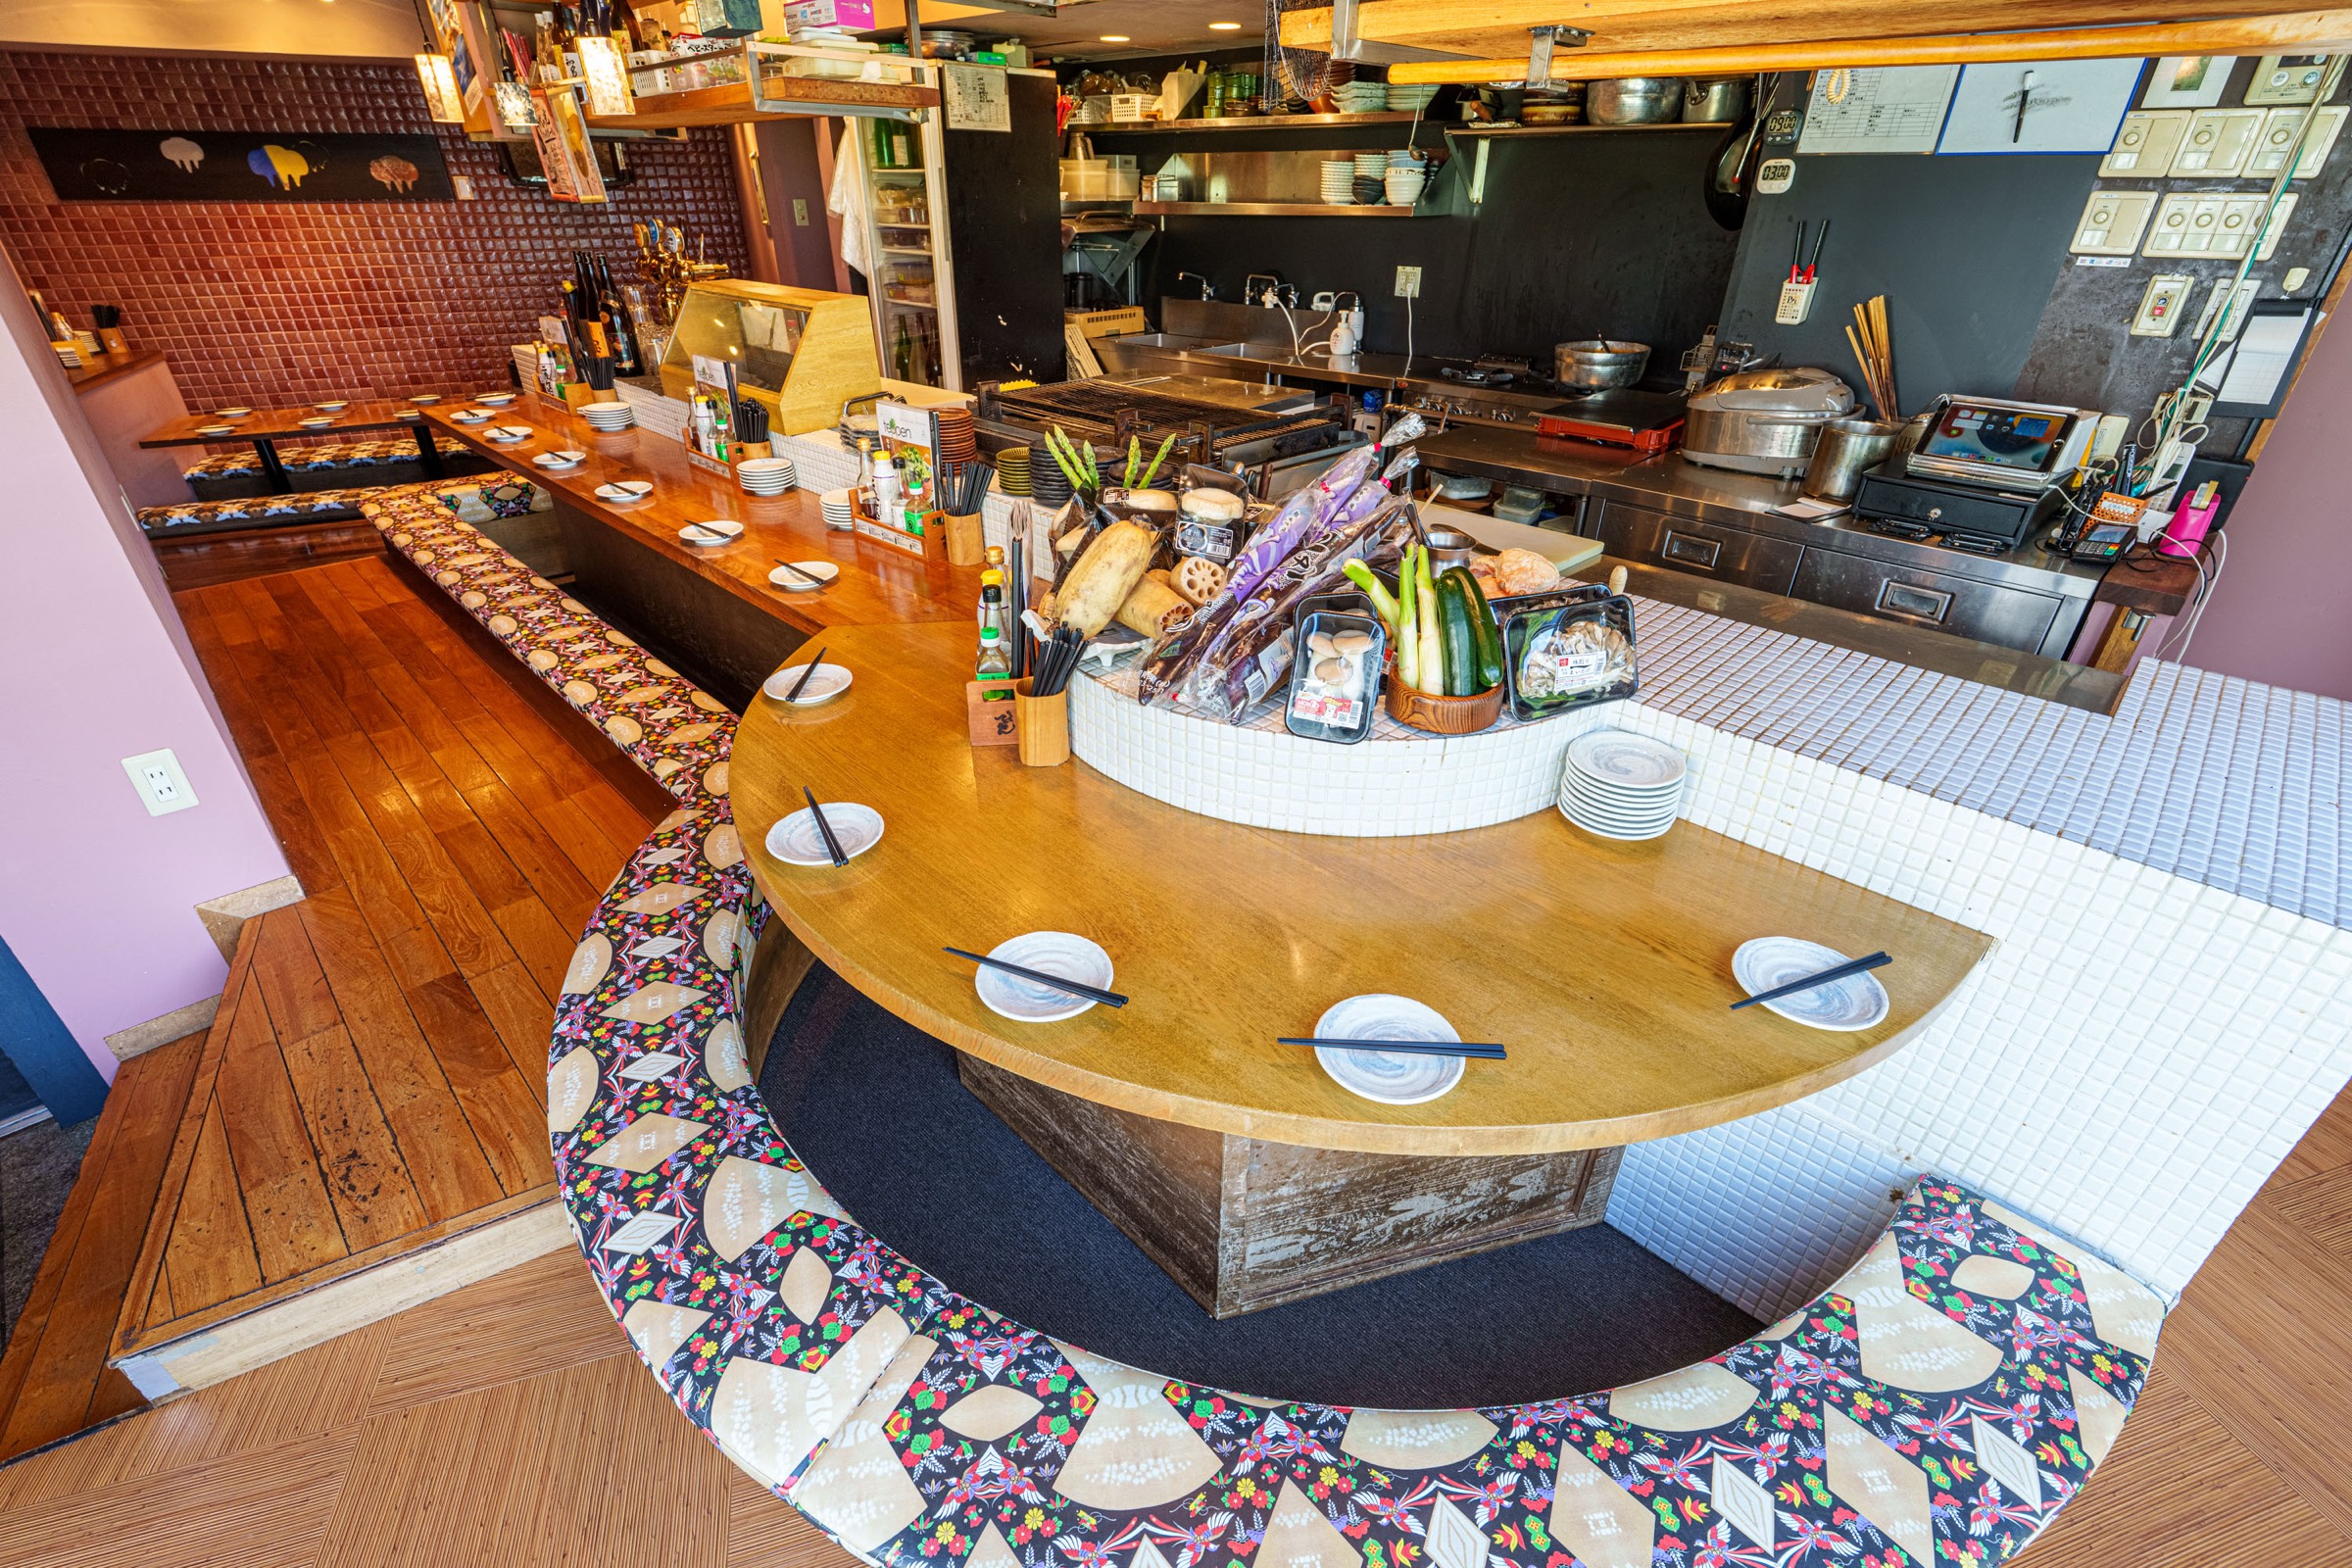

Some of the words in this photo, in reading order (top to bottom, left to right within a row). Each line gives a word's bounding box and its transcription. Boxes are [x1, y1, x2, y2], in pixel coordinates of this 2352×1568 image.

[687, 42, 730, 53] ベビースター
[1769, 116, 1797, 131] 0900
[1762, 166, 1790, 180] 0300
